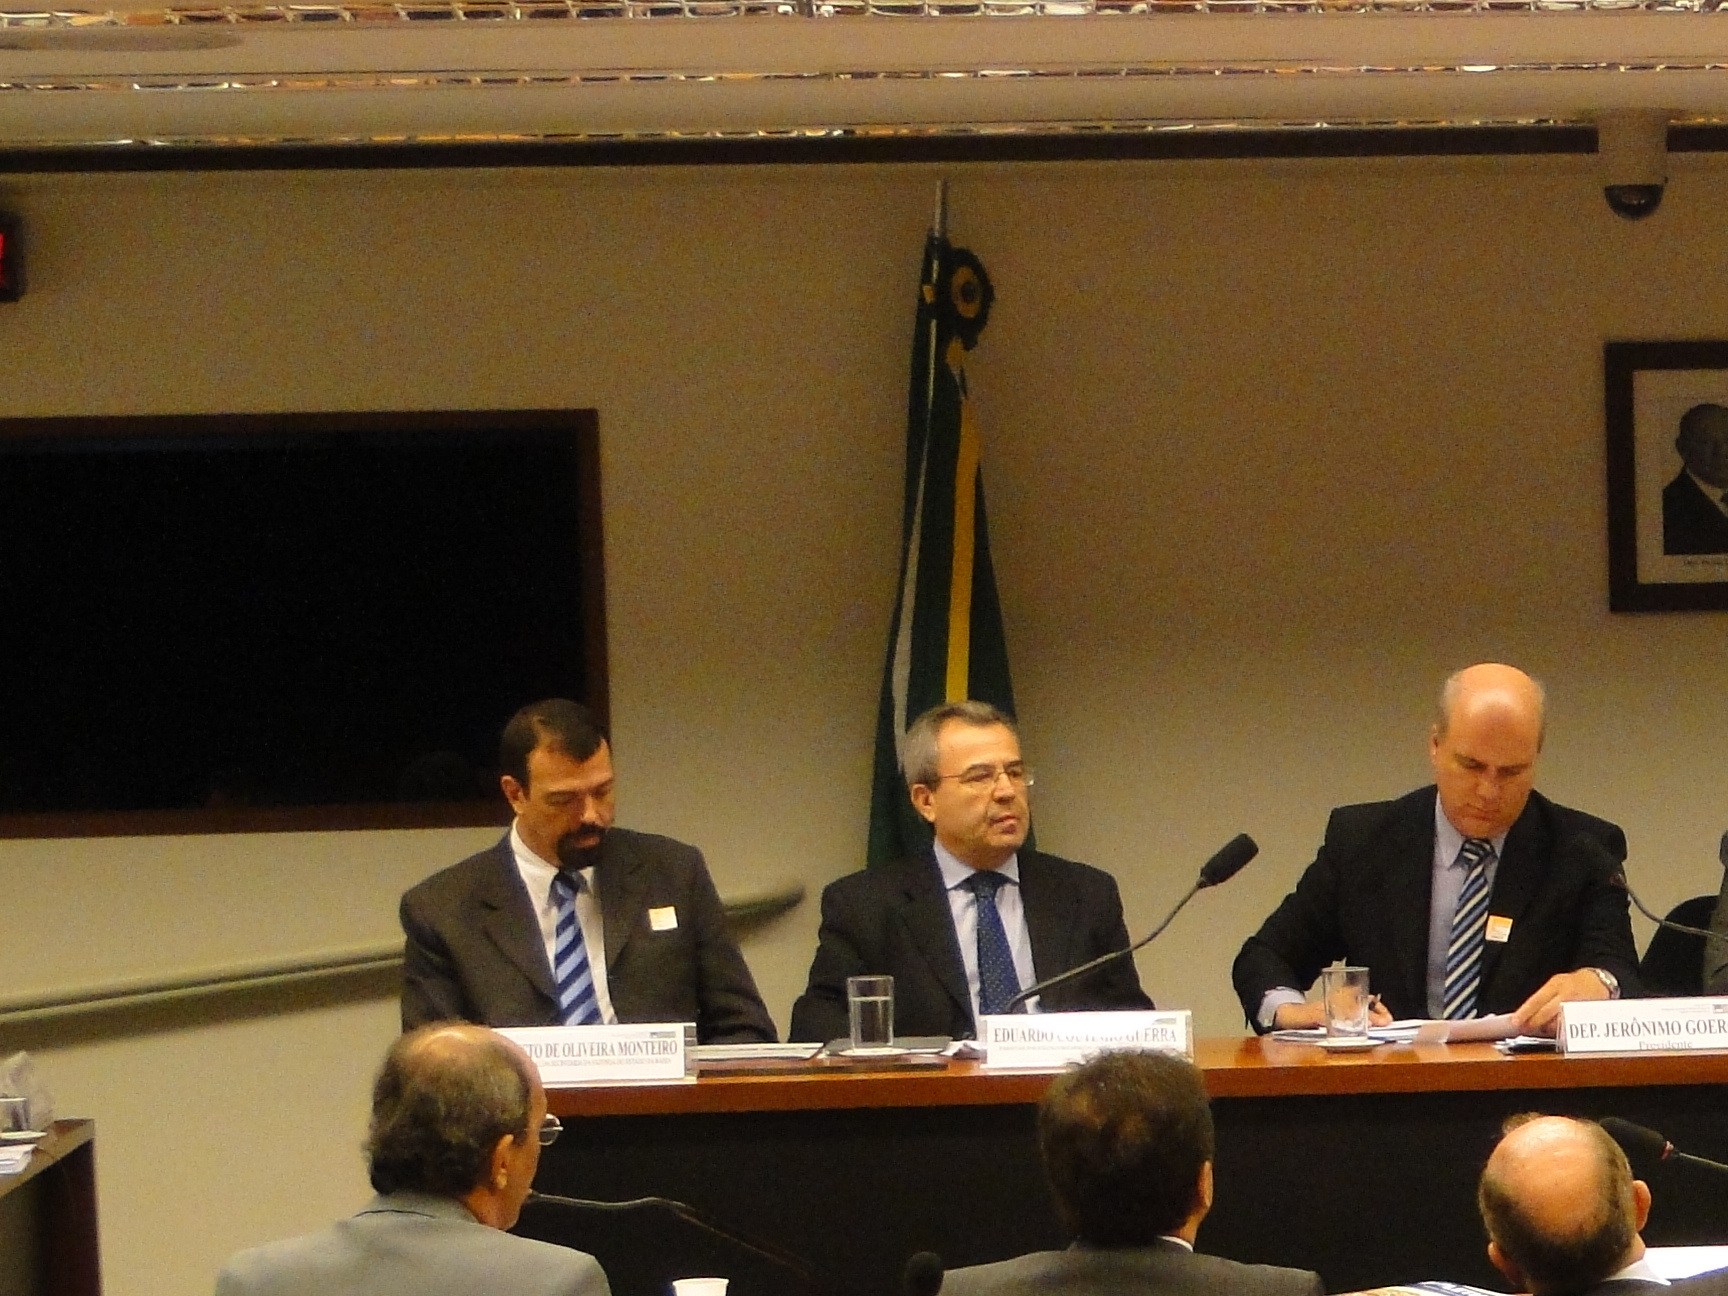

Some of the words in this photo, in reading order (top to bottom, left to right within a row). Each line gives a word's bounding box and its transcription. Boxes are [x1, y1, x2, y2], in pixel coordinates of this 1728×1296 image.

[993, 1026, 1055, 1044] EDUARDO
[1568, 1022, 1601, 1040] DEP.
[1604, 1017, 1682, 1039] JERÔNIMO
[545, 1042, 560, 1059] DE
[562, 1040, 617, 1058] OLIVEIRA
[618, 1039, 678, 1057] MONTEIRO
[1638, 1039, 1694, 1051] Presidente
